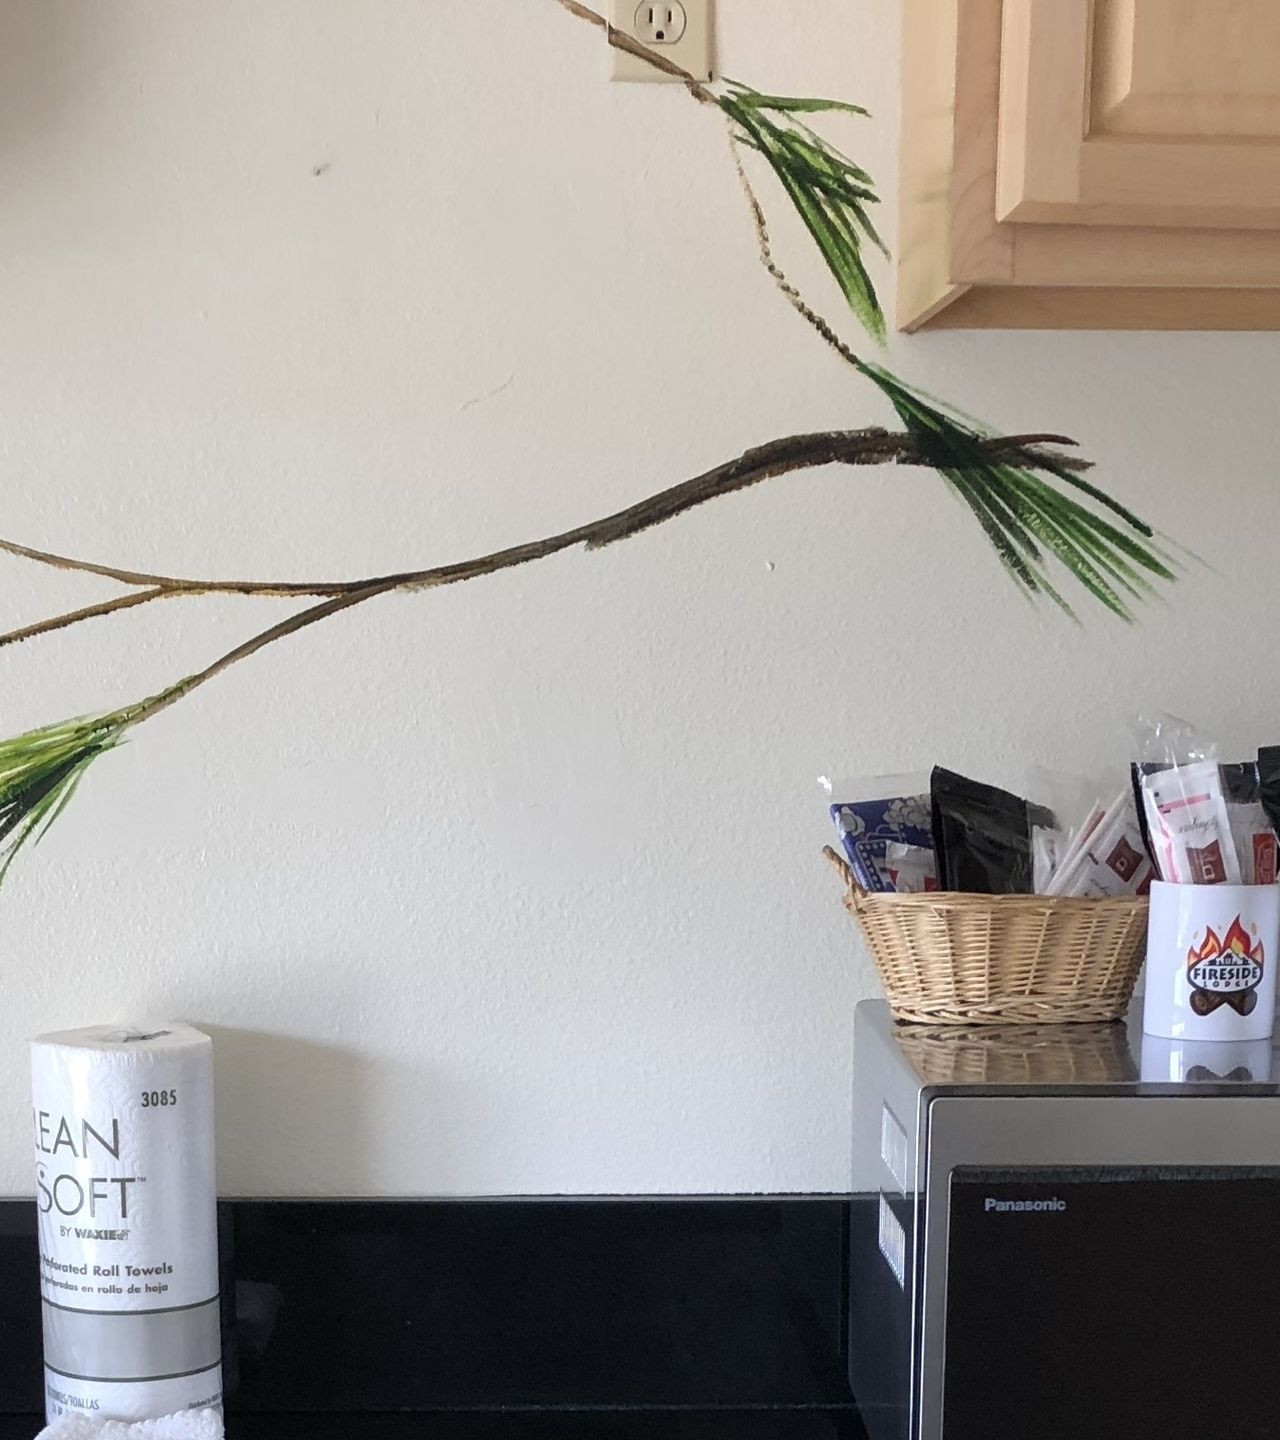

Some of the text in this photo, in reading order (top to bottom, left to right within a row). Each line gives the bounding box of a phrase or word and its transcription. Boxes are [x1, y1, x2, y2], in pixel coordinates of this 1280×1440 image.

[1193, 966, 1258, 980] FIRESIDE
[1203, 980, 1249, 988] LODGE
[141, 1089, 177, 1107] 3085
[985, 1197, 1066, 1211] Panasonic
[60, 1225, 72, 1237] BY
[93, 1264, 119, 1277] Roll
[125, 1262, 173, 1277] Towels
[81, 1285, 93, 1293] en
[97, 1284, 123, 1294] rollo
[127, 1284, 140, 1294] de
[145, 1283, 168, 1294] hoja
